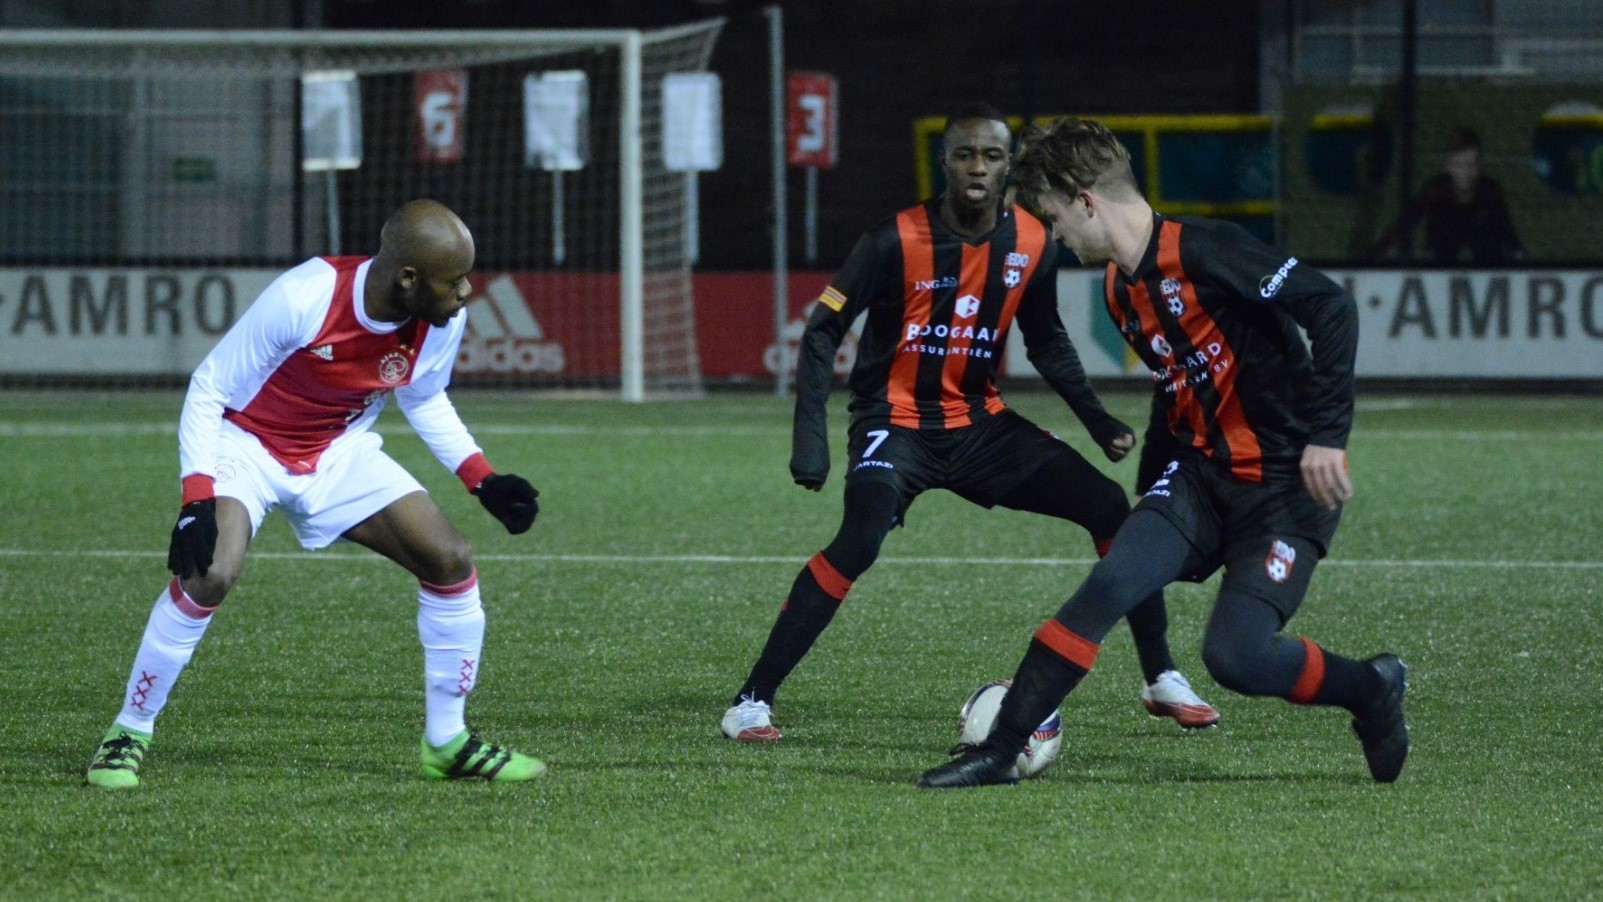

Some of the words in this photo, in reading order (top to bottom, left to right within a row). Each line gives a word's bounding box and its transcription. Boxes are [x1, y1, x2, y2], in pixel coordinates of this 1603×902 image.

[421, 91, 456, 147] 6
[798, 94, 825, 150] 3
[914, 279, 940, 291] ING
[12, 274, 236, 335] AMRO
[906, 323, 999, 342] BOOGAA
[453, 337, 566, 373] didas
[862, 430, 889, 458] 7
